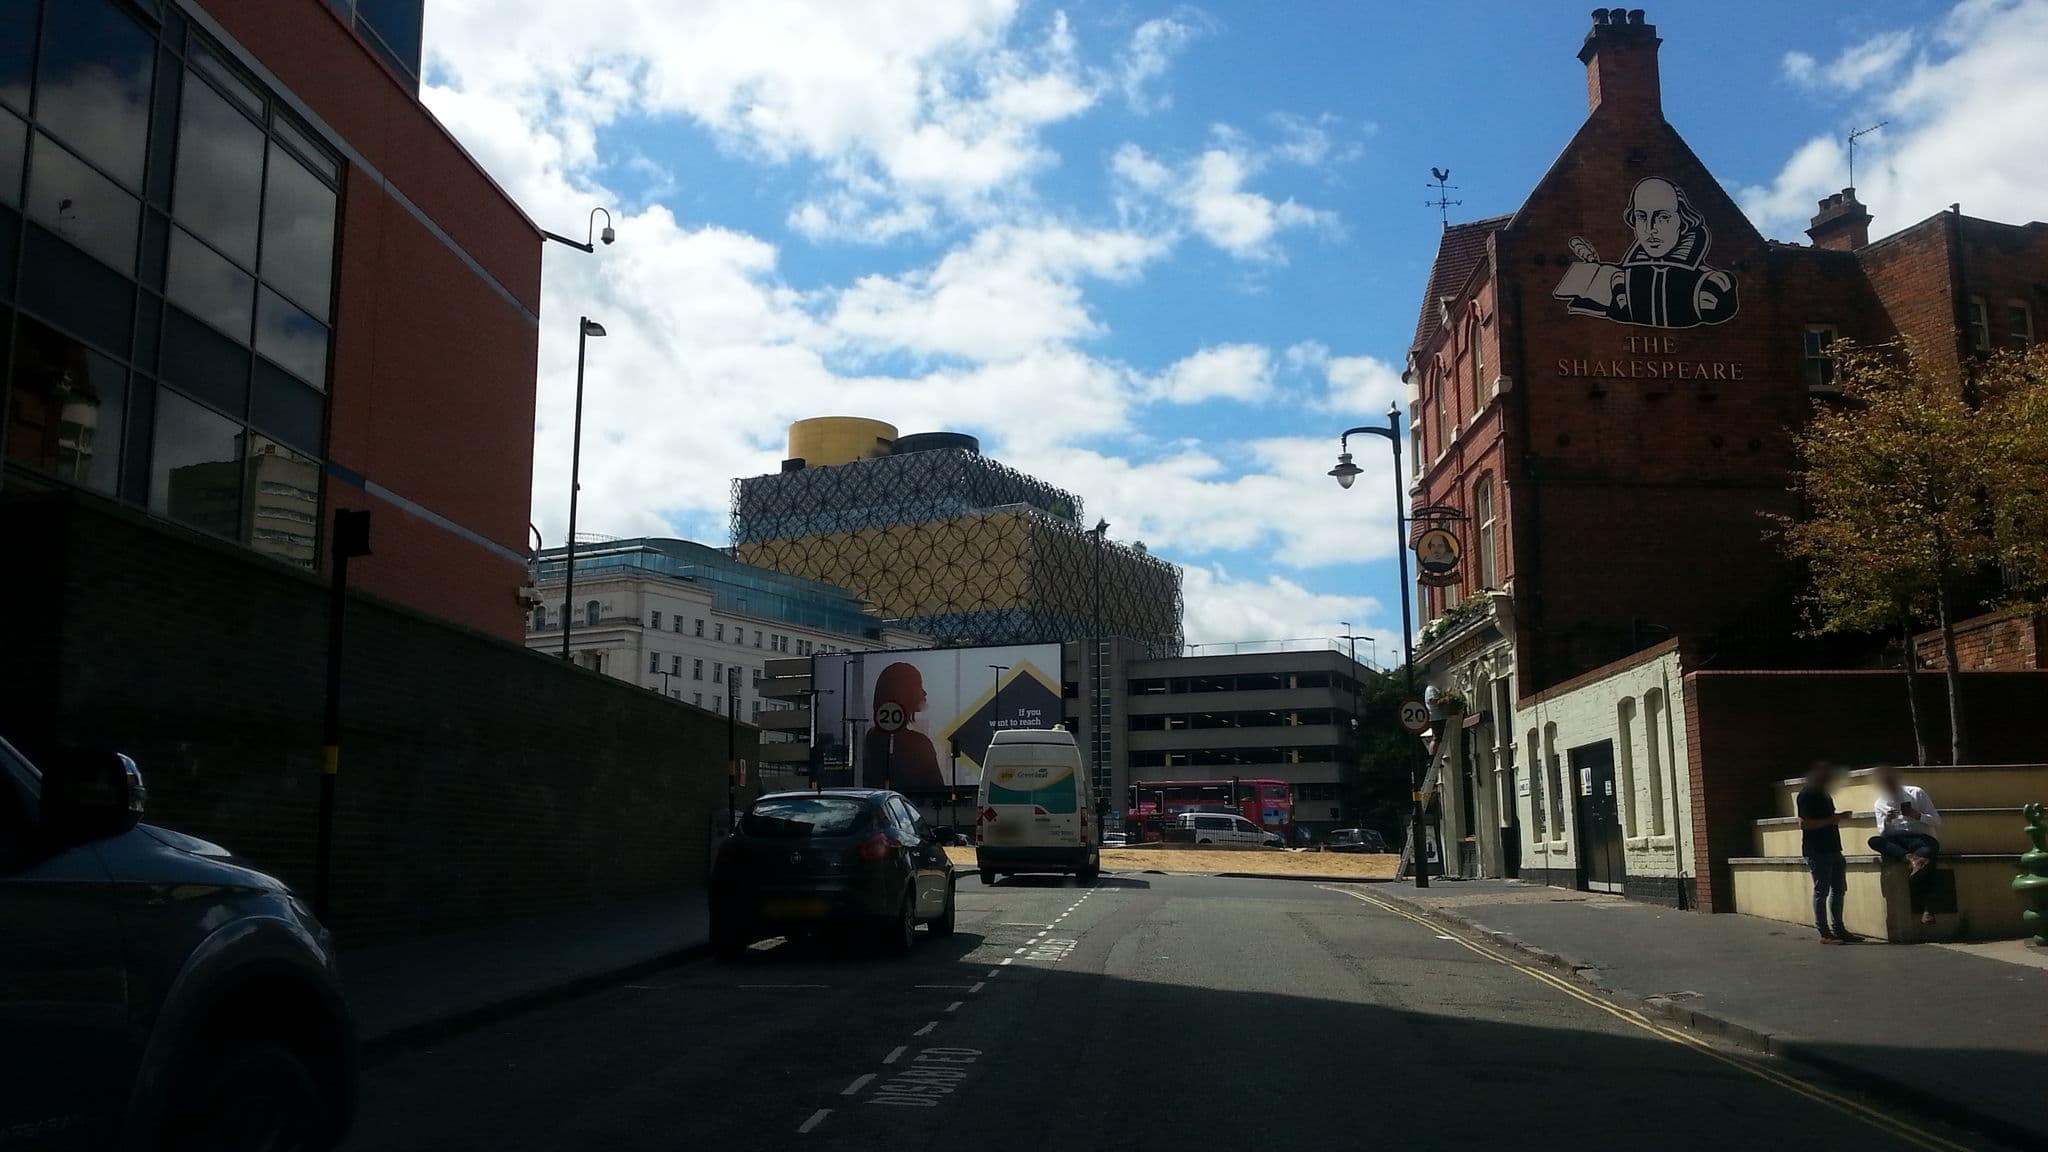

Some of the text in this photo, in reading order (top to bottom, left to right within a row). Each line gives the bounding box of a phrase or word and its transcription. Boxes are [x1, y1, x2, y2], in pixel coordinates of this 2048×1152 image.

[1626, 336, 1678, 354] THE
[1557, 358, 1745, 381] SHAKESPEARE
[879, 709, 903, 724] 20
[1018, 708, 1041, 718] If you
[1403, 708, 1426, 723] 20
[1010, 719, 1018, 727] to
[1019, 717, 1041, 727] reach
[864, 1047, 983, 1107] DISABLED
